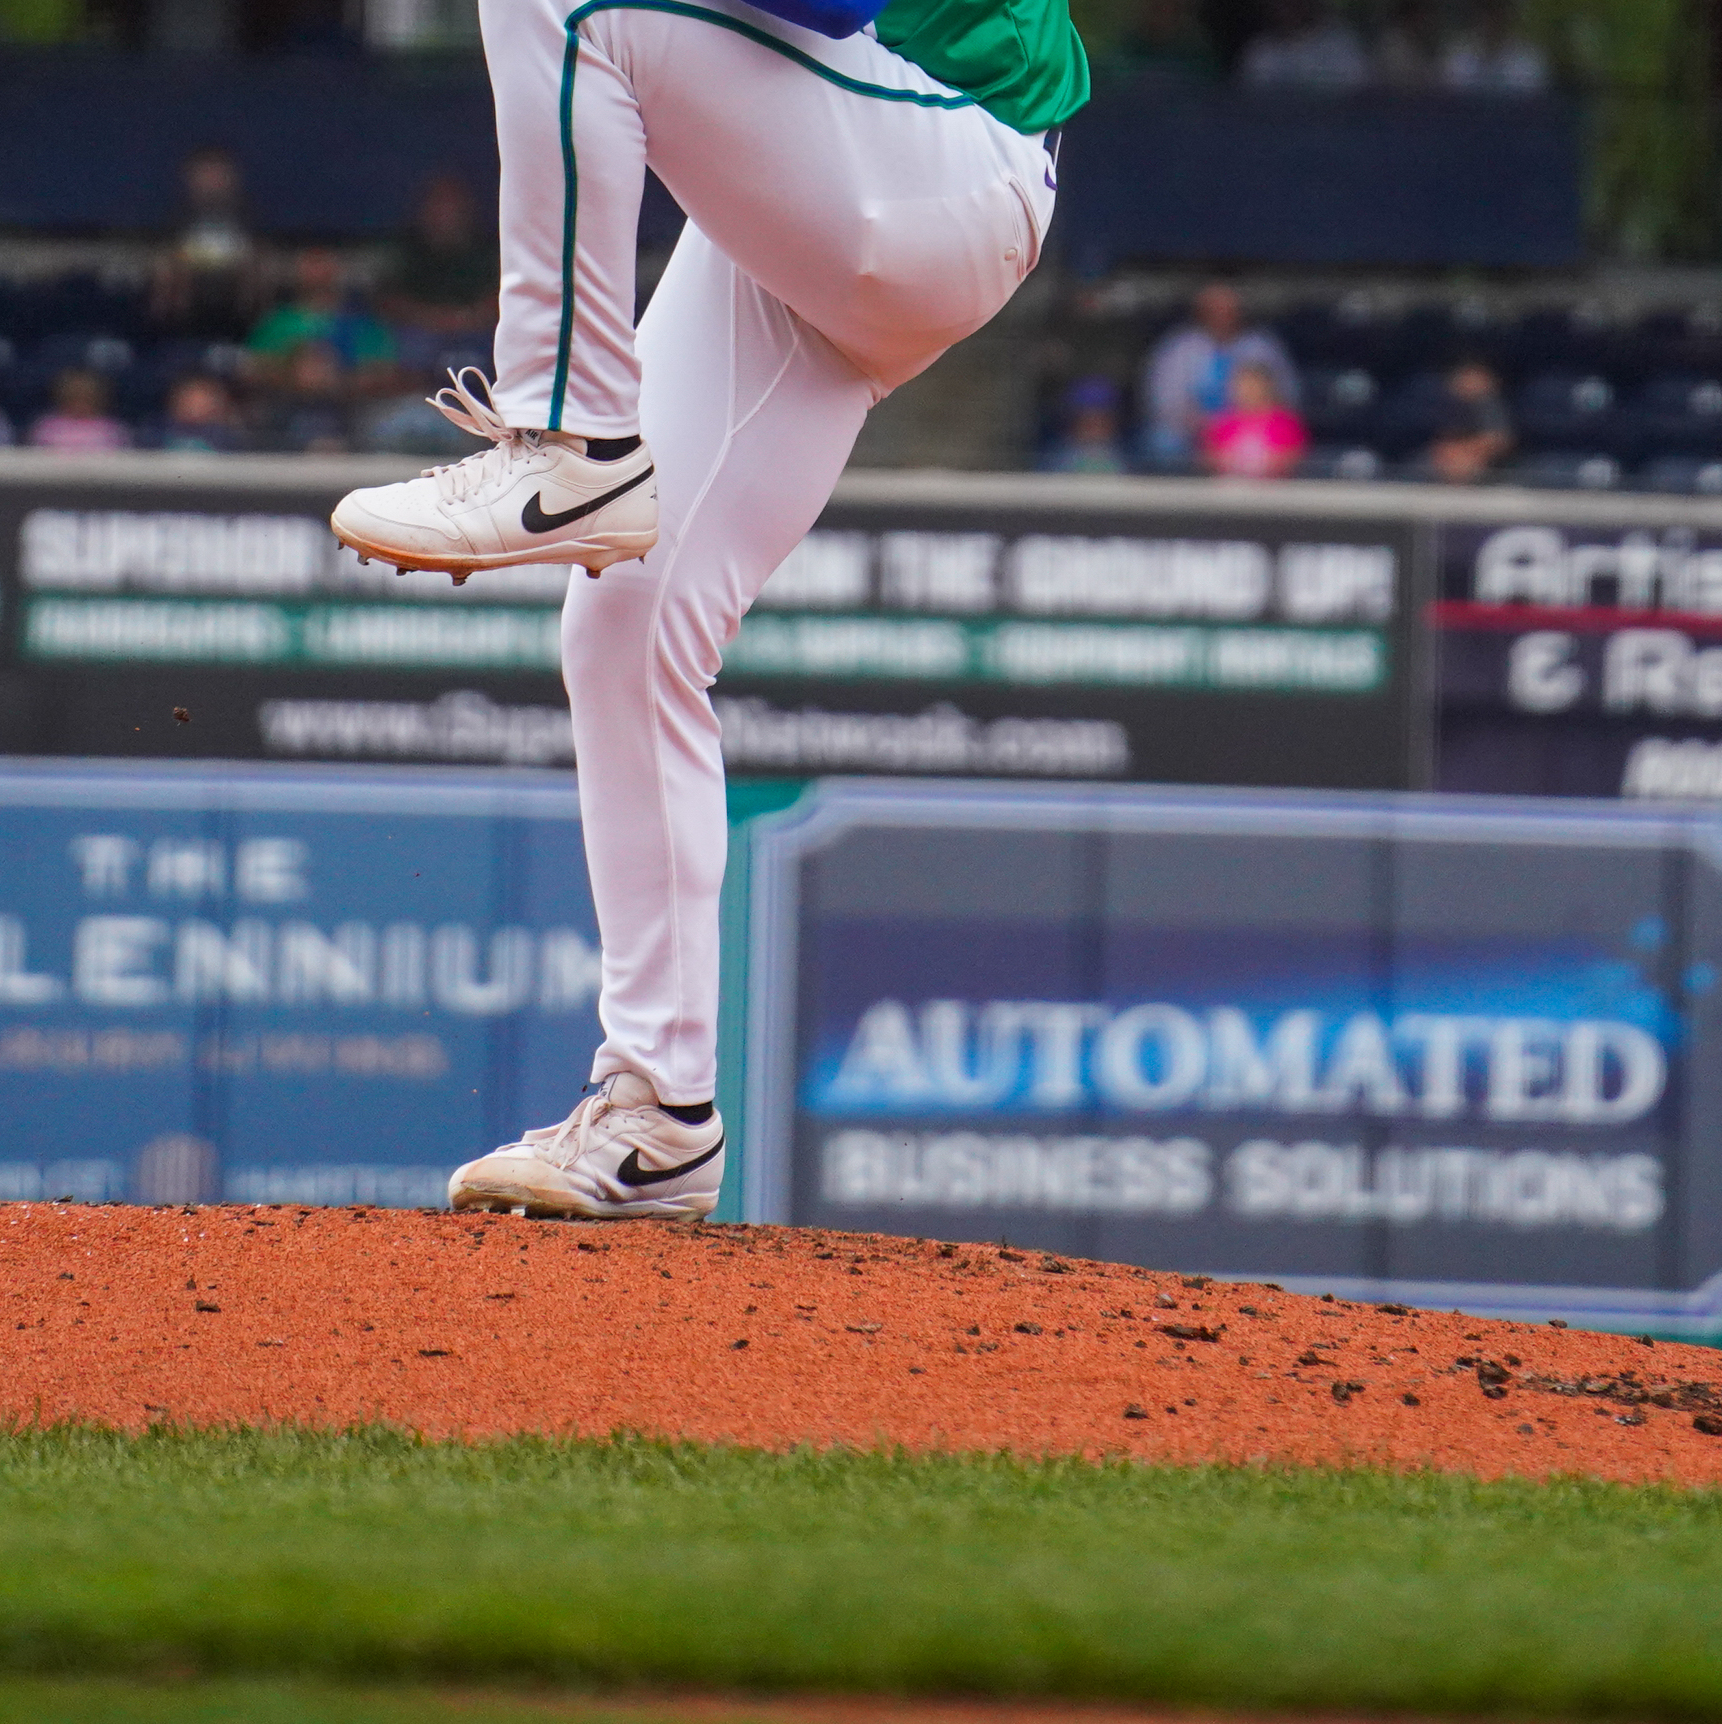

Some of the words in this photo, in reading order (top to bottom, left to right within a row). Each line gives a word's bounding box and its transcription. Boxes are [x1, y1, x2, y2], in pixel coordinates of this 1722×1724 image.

[71, 832, 313, 905] THE
[827, 997, 1671, 1126] AUTOMATED
[820, 1128, 1213, 1216] BUSINESS
[1225, 1140, 1665, 1232] SOLUTIONS
